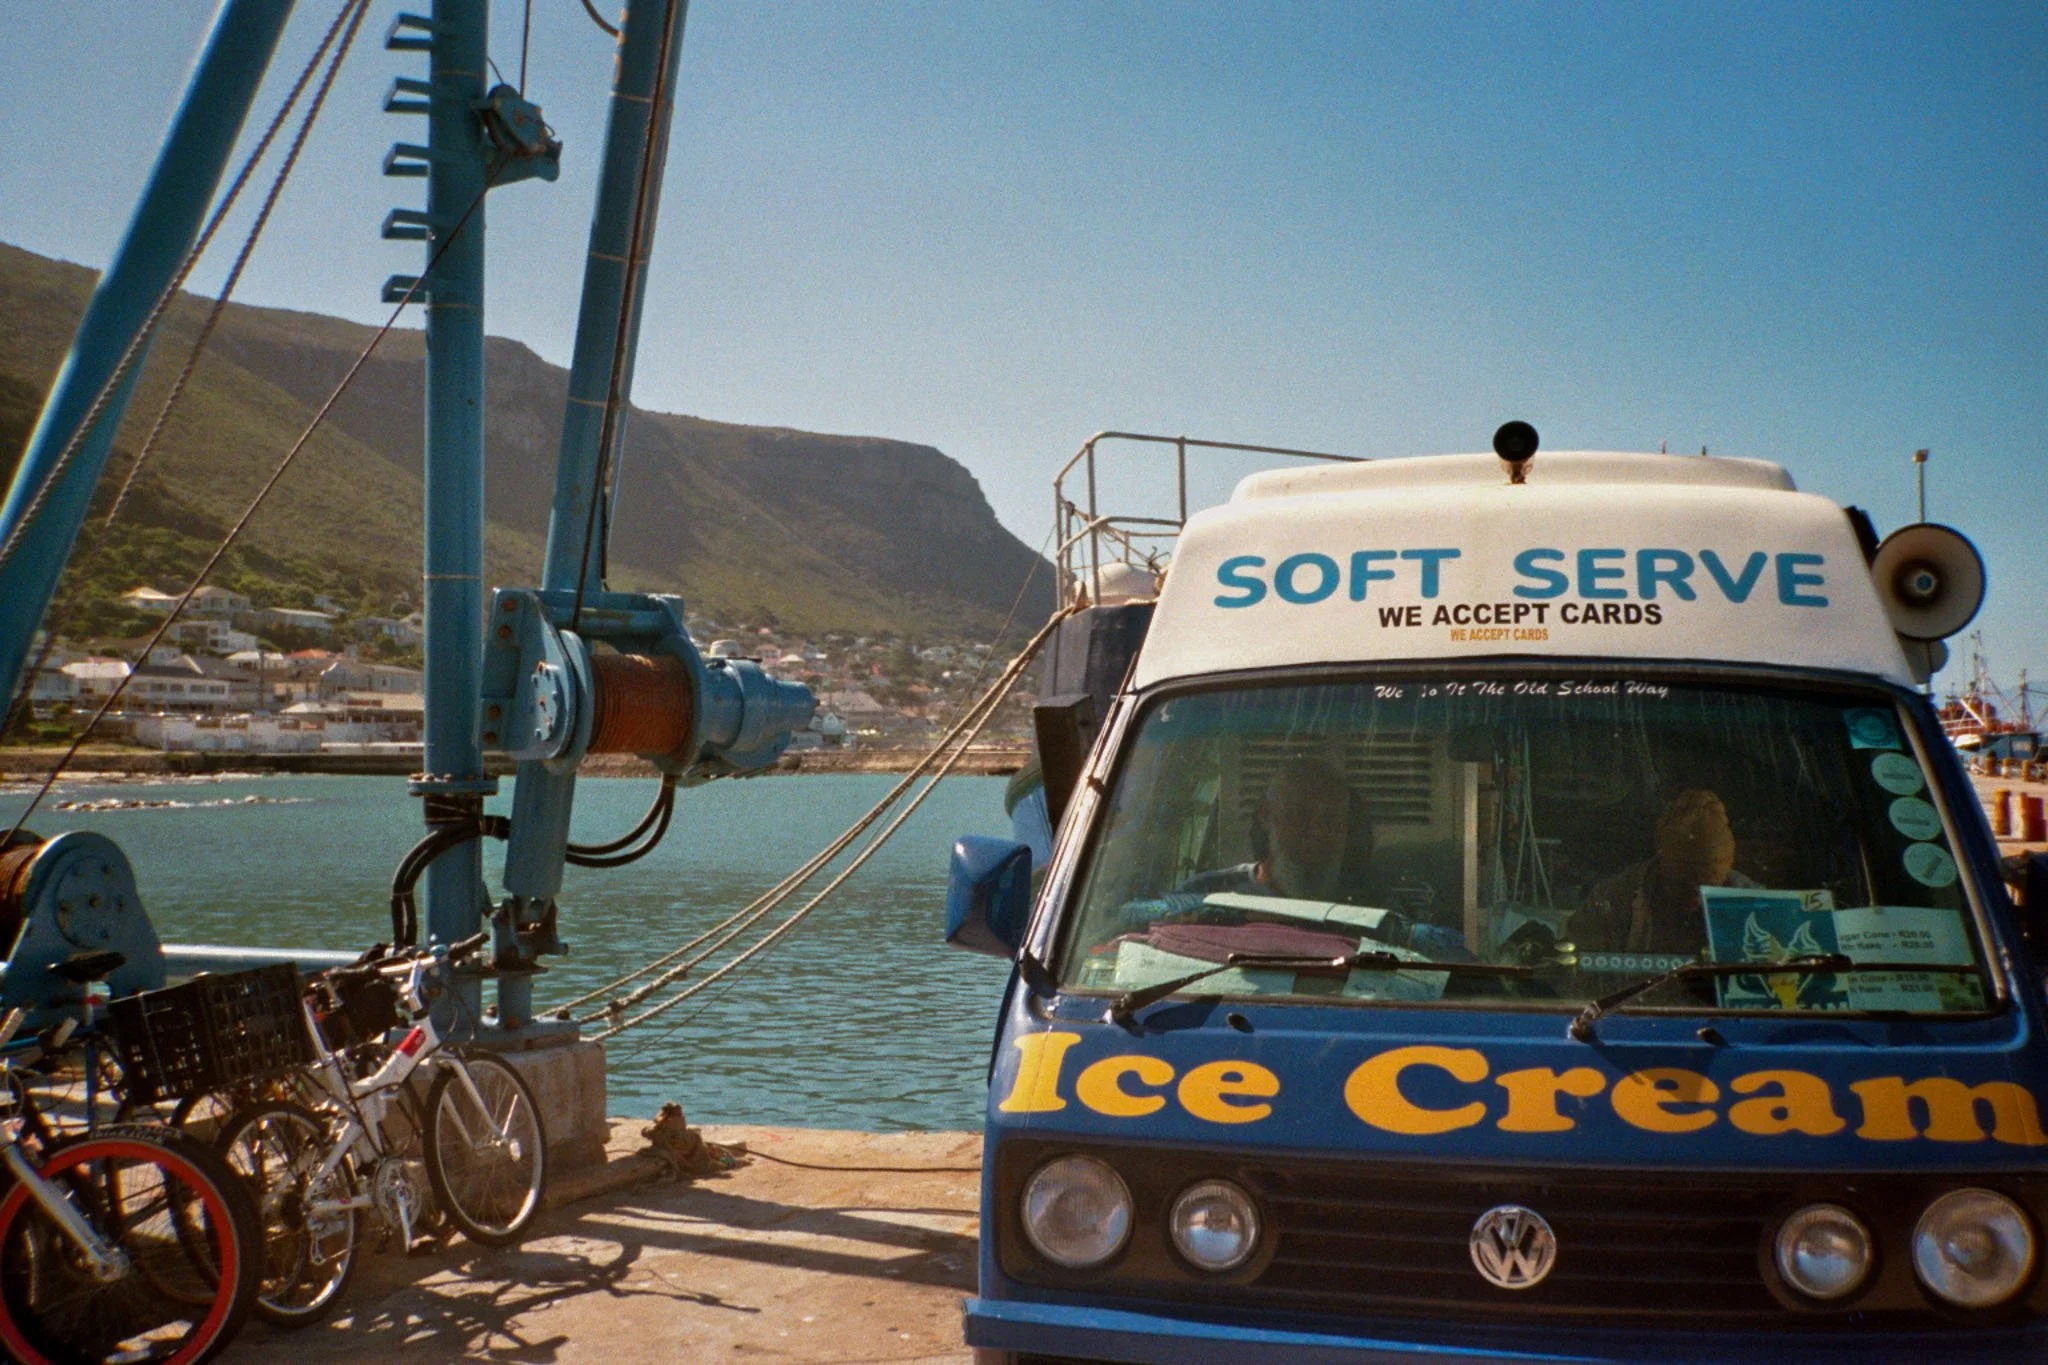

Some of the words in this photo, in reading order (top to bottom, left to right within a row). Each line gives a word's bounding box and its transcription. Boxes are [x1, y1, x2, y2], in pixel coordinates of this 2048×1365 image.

[1213, 548, 1462, 609] SOFT
[1512, 548, 1829, 607] SERVE
[1378, 606, 1422, 628] WE
[1432, 603, 1550, 626] ACCEPT
[1560, 602, 1663, 625] CARDS
[1450, 629, 1466, 641] WE
[1469, 628, 1511, 641] ACCEPT
[1513, 628, 1549, 641] CARDS
[1374, 685, 1404, 698] We
[1446, 682, 1466, 695] It
[1472, 681, 1505, 695] The
[1513, 681, 1549, 695] Old
[1556, 680, 1618, 696] School
[1624, 681, 1669, 698] Way
[998, 1031, 1280, 1124] Ice
[1344, 1045, 2048, 1146] Cream
[1470, 1204, 1557, 1289] VW
